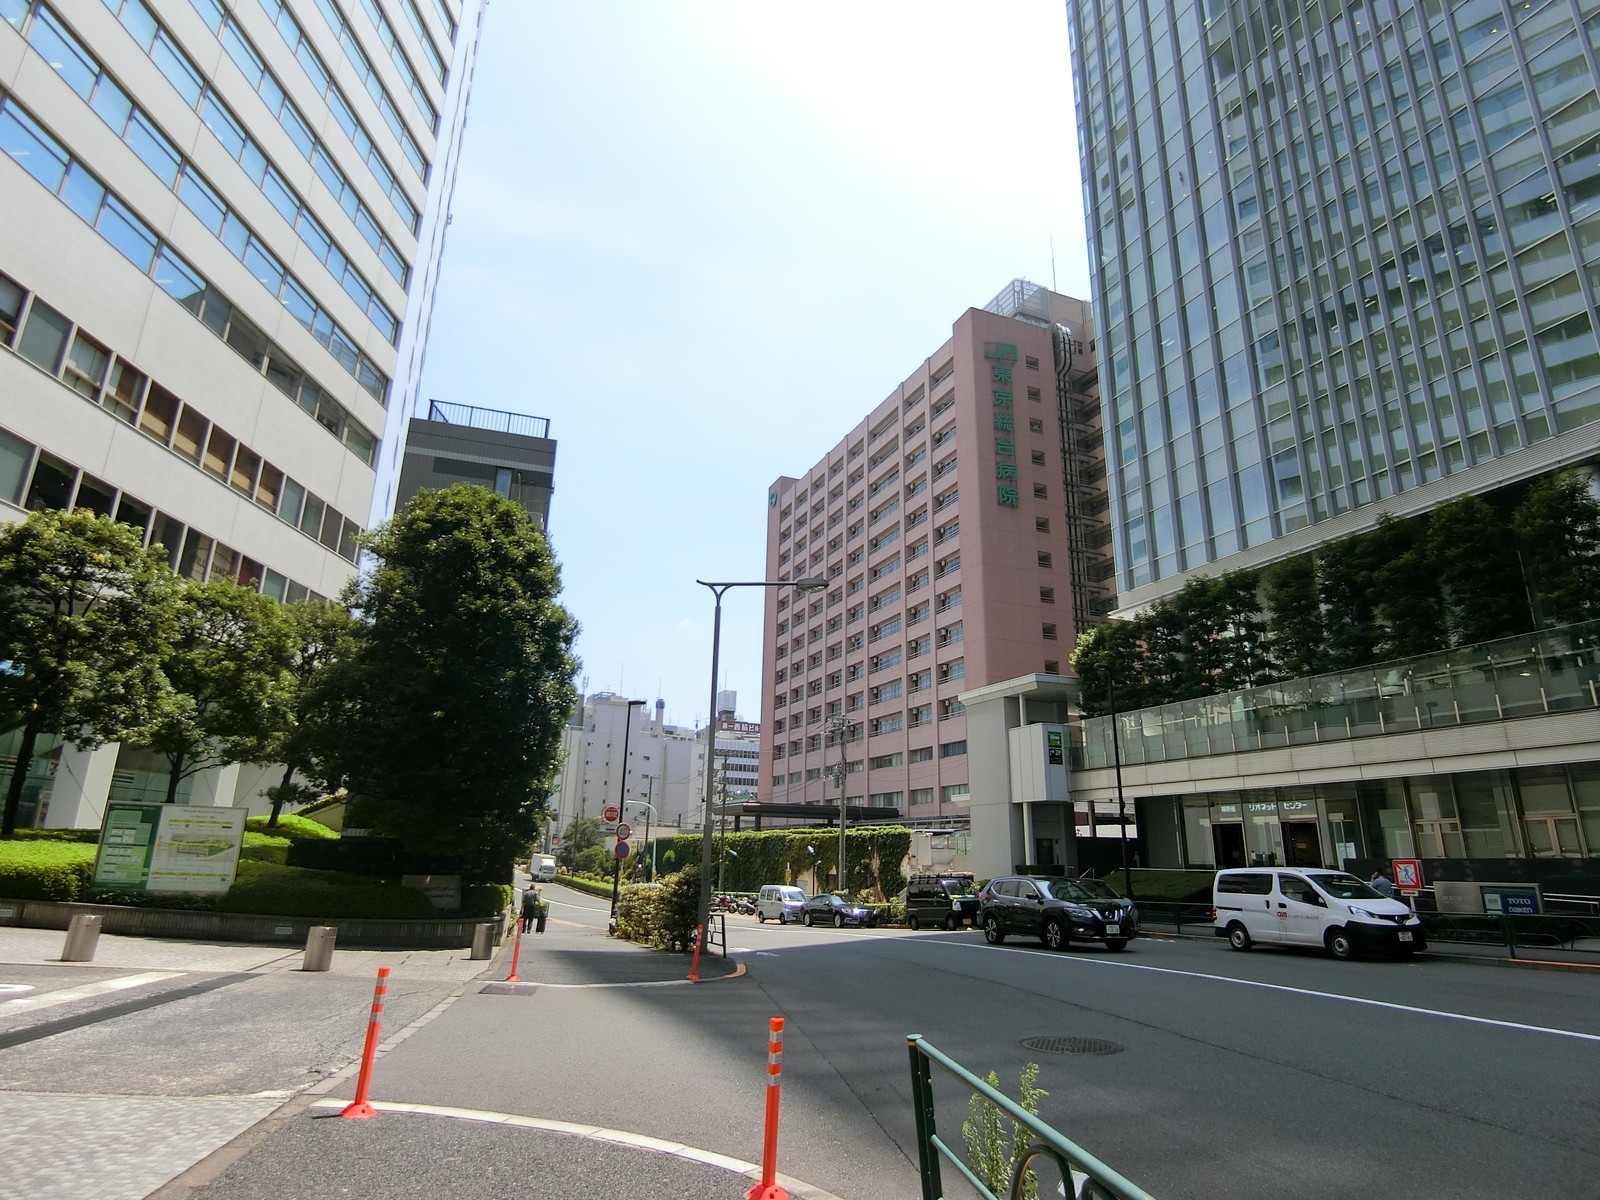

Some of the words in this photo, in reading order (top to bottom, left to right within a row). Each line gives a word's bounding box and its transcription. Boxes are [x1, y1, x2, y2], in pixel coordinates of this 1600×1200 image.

[1248, 803, 1277, 812] リオネット
[1283, 801, 1307, 810] センター
